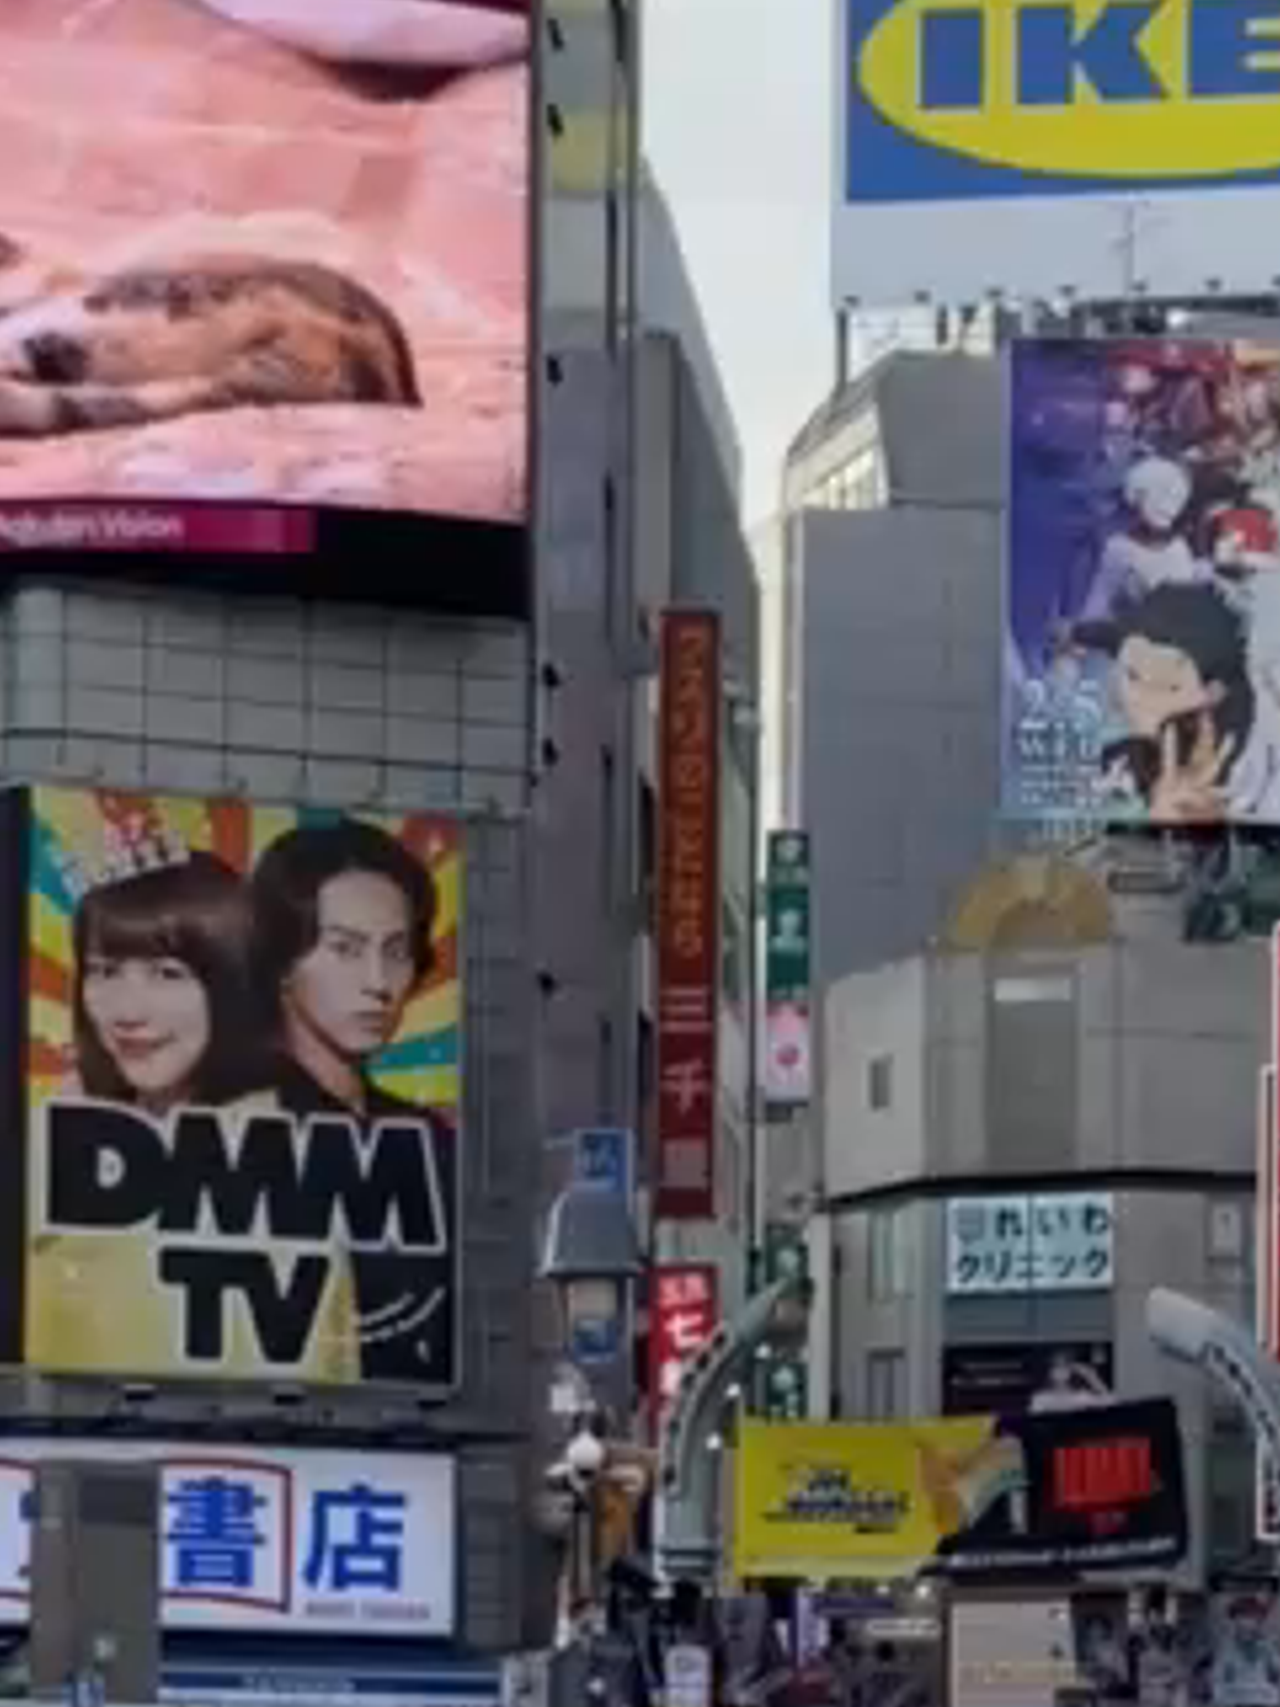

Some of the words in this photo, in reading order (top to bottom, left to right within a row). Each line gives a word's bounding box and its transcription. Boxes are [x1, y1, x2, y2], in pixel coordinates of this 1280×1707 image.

[100, 509, 183, 540] Vision
[661, 987, 713, 1189] 三千
[46, 1104, 442, 1250] DMM
[995, 1203, 1108, 1238] れいわ
[957, 1248, 1108, 1284] クリニック
[159, 1250, 329, 1363] TV
